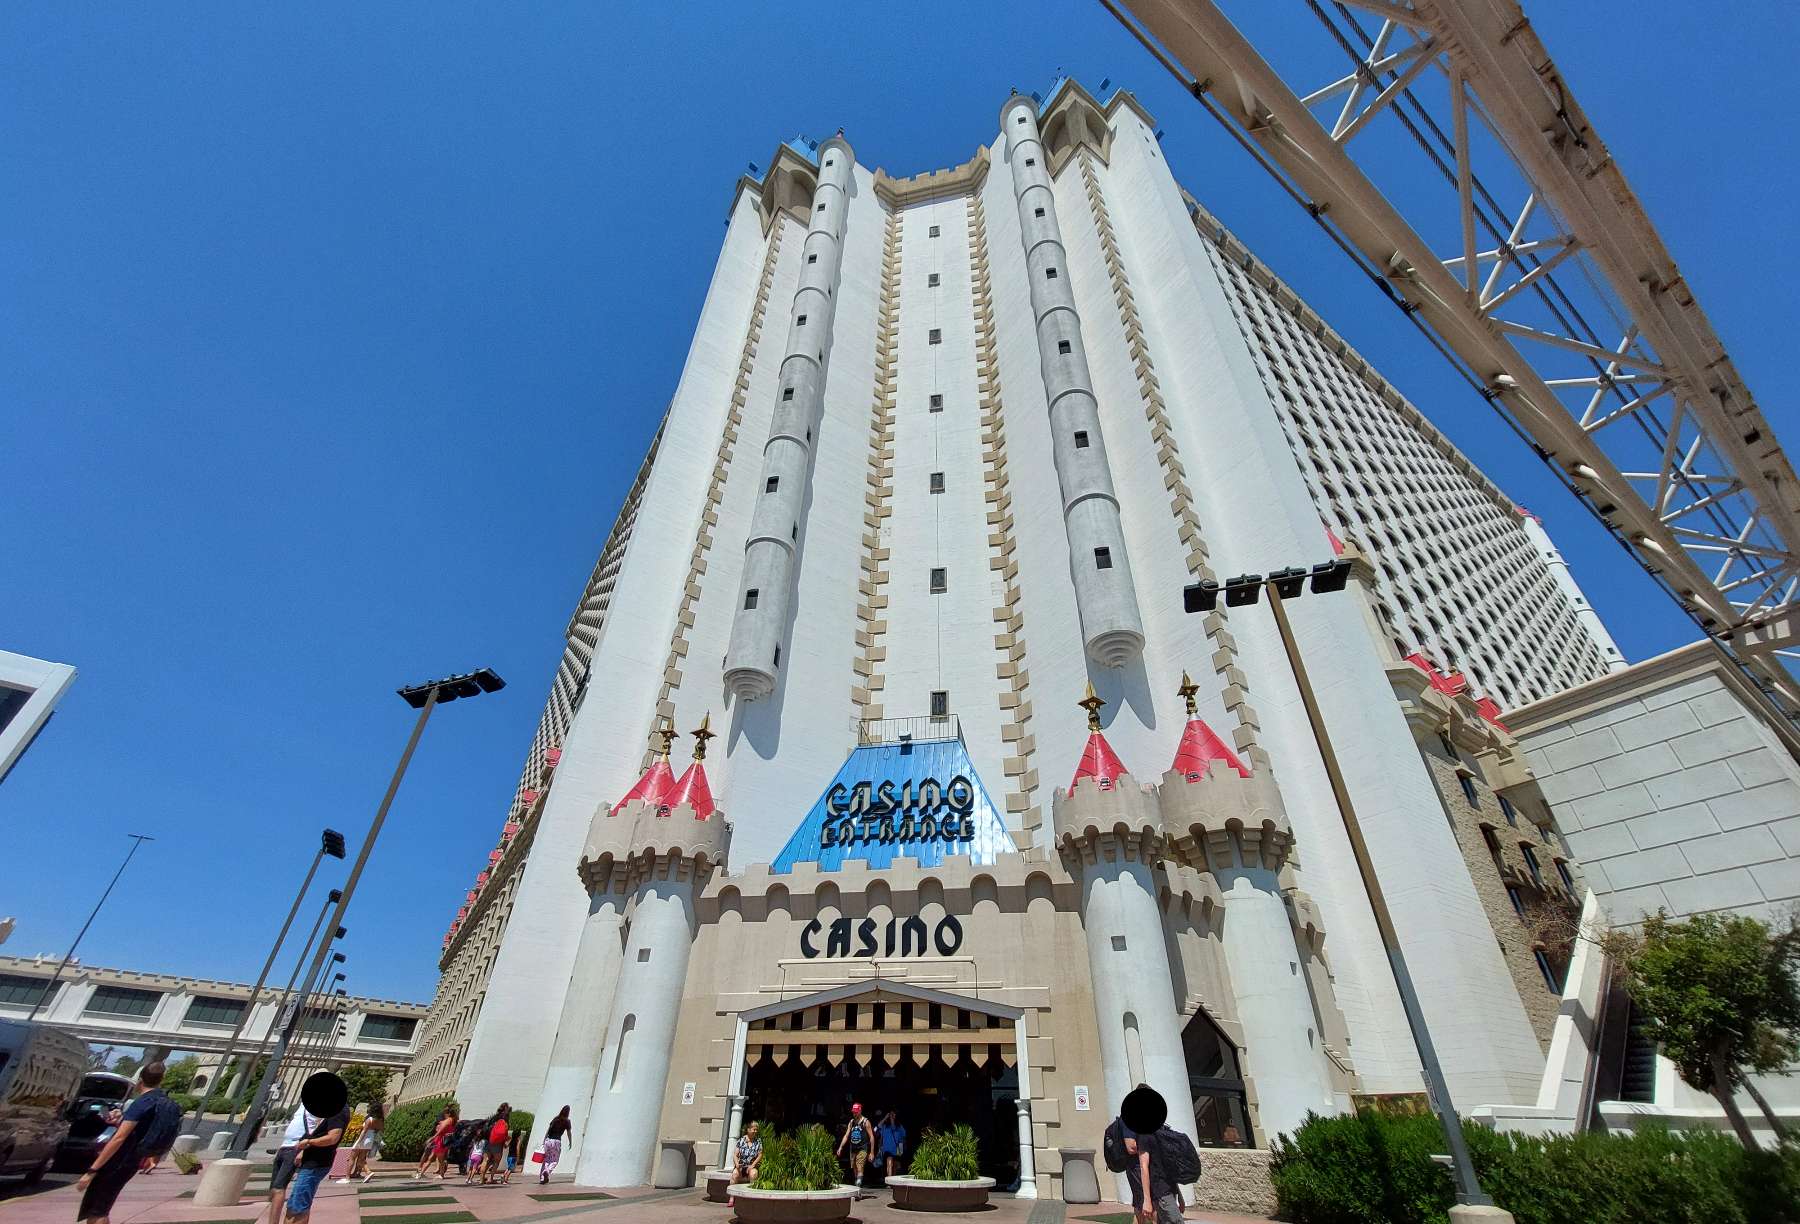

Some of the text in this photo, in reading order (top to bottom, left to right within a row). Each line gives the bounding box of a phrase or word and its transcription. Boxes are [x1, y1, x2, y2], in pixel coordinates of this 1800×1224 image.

[826, 775, 974, 818] CASINO
[821, 812, 974, 848] ENTRANCE
[801, 914, 963, 958] CASINO
